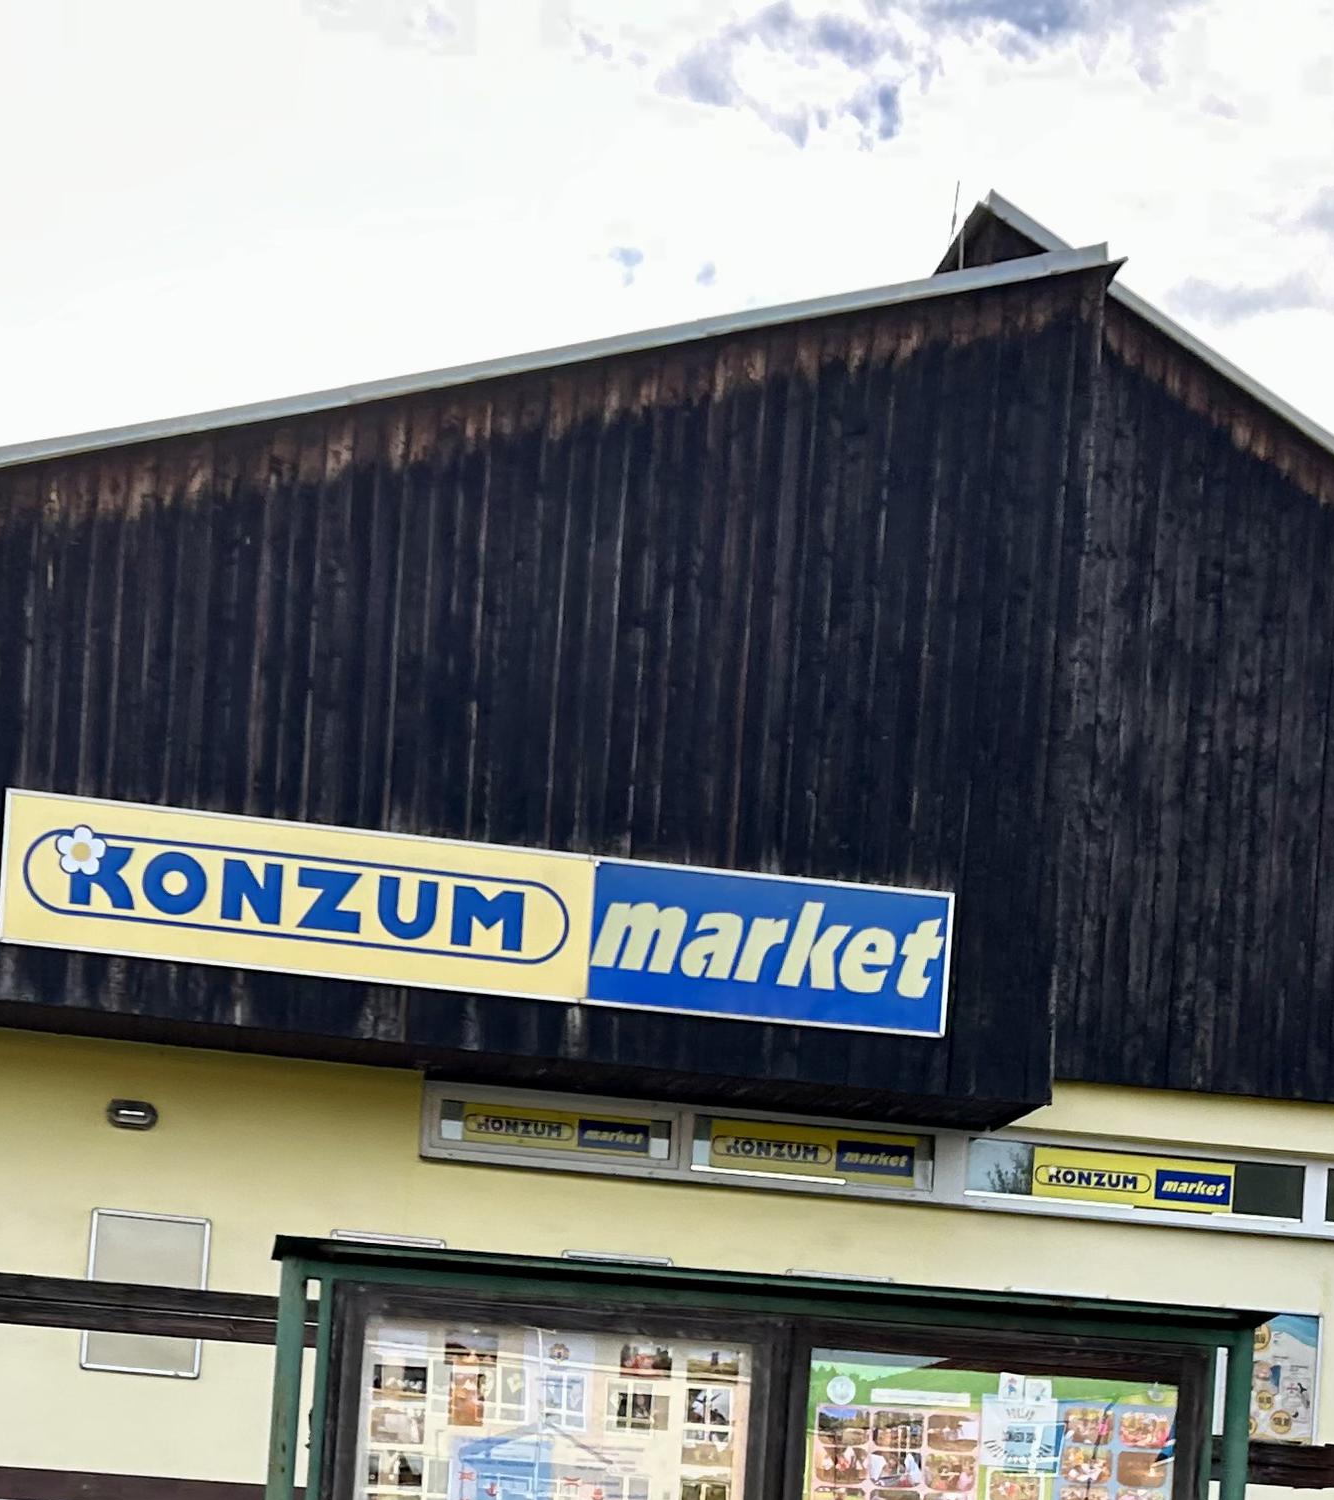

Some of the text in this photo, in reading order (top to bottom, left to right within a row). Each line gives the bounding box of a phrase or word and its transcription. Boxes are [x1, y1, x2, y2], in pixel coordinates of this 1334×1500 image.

[69, 845, 945, 999] KONZUM market
[477, 1117, 644, 1145] KONZUM market
[726, 1138, 908, 1168] KONZUM market
[1048, 1169, 1226, 1197] KONZUM market
